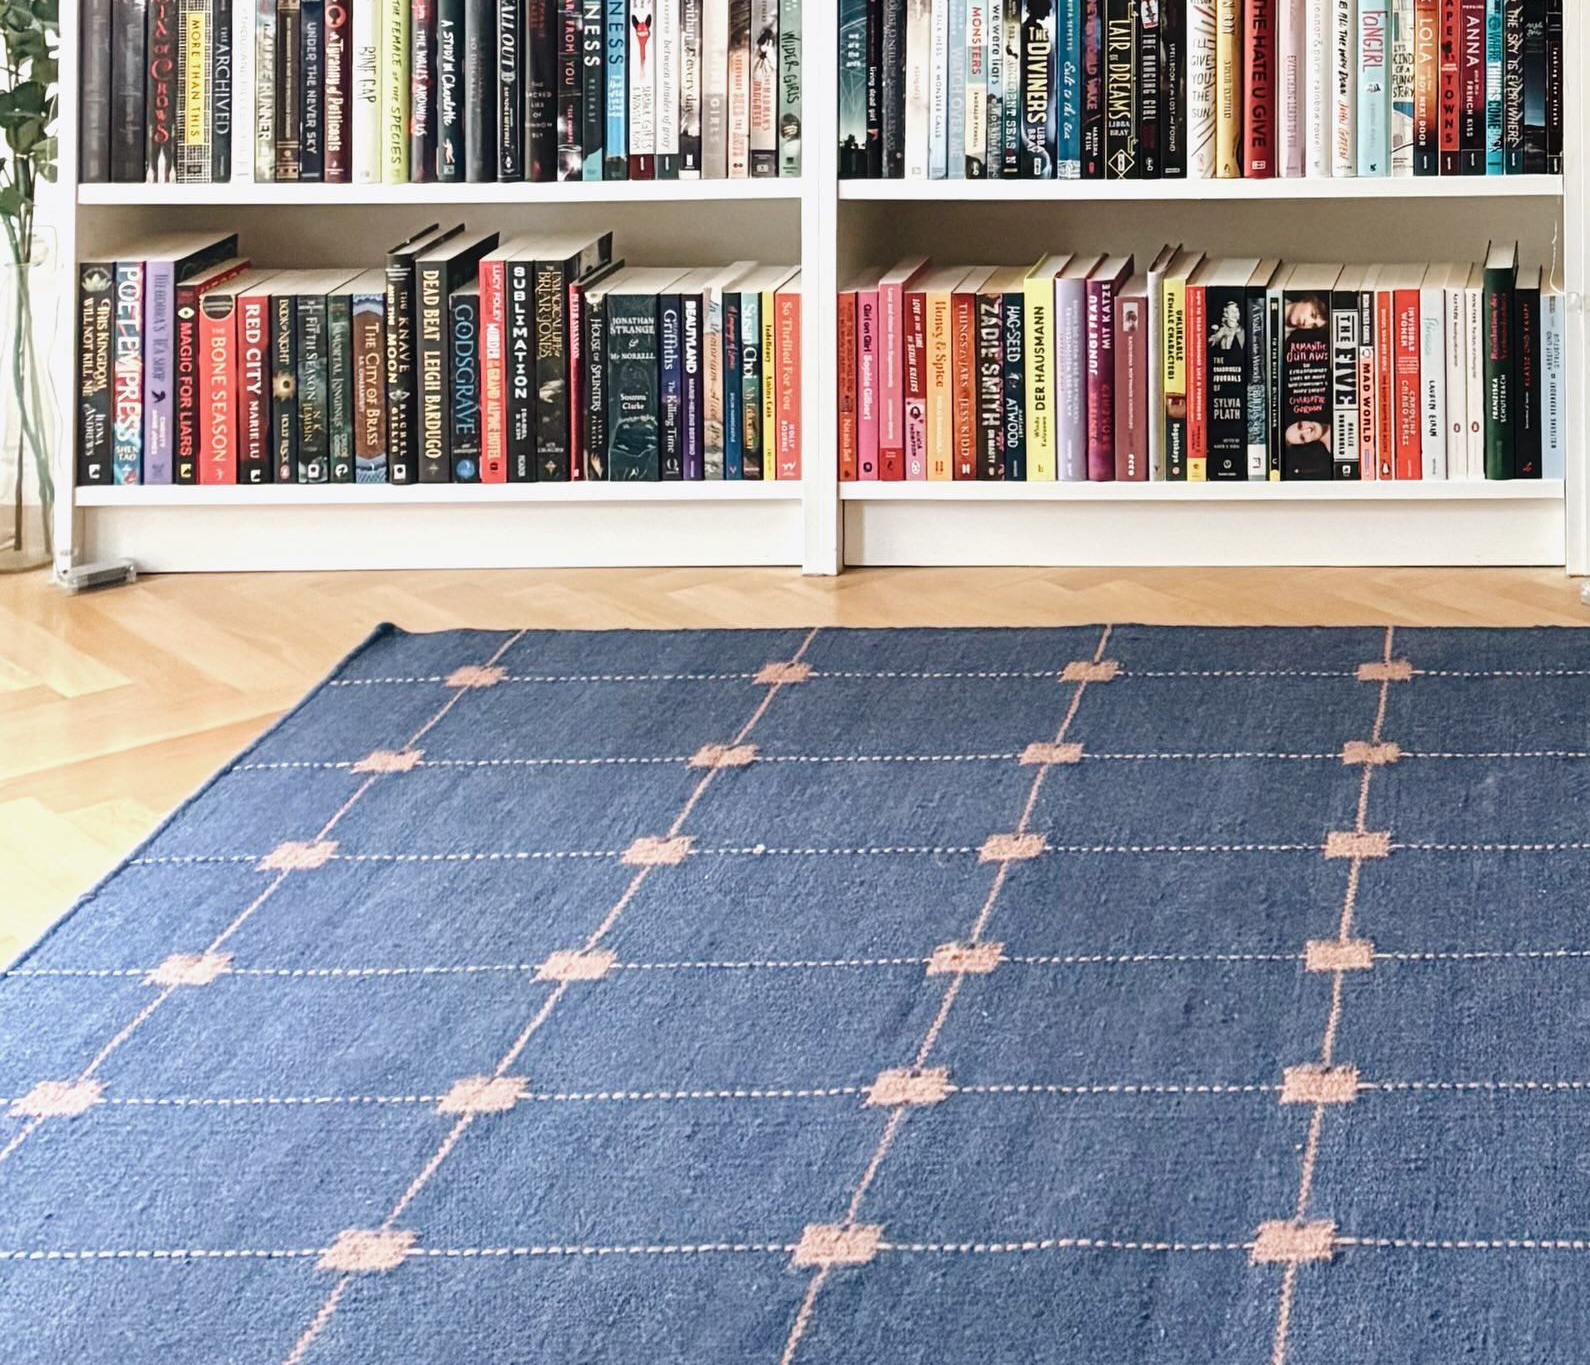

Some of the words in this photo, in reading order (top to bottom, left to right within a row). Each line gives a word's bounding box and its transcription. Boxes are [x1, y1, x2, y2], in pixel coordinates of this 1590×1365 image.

[191, 20, 200, 57] MORE
[584, 5, 600, 66] NESS
[972, 7, 982, 74] MONSTERS
[1028, 27, 1050, 41] THE
[1420, 19, 1433, 63] LOLA
[1466, 16, 1480, 67] ANNA
[1253, 34, 1267, 81] HATE
[191, 65, 200, 100] THAN
[1026, 43, 1051, 123] DIVINERS
[1252, 88, 1266, 97] U
[191, 107, 200, 136] THIS
[1252, 104, 1266, 148] GIVE
[116, 267, 140, 331] POET
[424, 270, 438, 305] DEAD
[246, 304, 260, 343] RED
[424, 309, 439, 341] BEAT
[513, 267, 528, 398] SUBLIMATION
[610, 326, 655, 334] STRANGE
[612, 317, 654, 325] JONATHAN
[980, 303, 1000, 357] ZADIE
[1340, 316, 1350, 343] THE
[210, 337, 226, 385] BONE
[1034, 307, 1046, 382] HAUSMANN
[116, 336, 142, 441] EMPRESS
[246, 348, 261, 394] CITY
[424, 351, 440, 390] LEIGH
[455, 304, 475, 434] GODSGRAVE
[1336, 347, 1356, 405] FIVE
[1363, 363, 1372, 392] MAD
[982, 363, 1000, 425] SMITH
[1034, 387, 1046, 410] DER
[1213, 398, 1241, 408] SYLVIA
[1213, 409, 1241, 419] PLATH
[211, 392, 226, 461] SEASON
[425, 395, 441, 458] BARDUGO
[1363, 398, 1372, 442] WORLD
